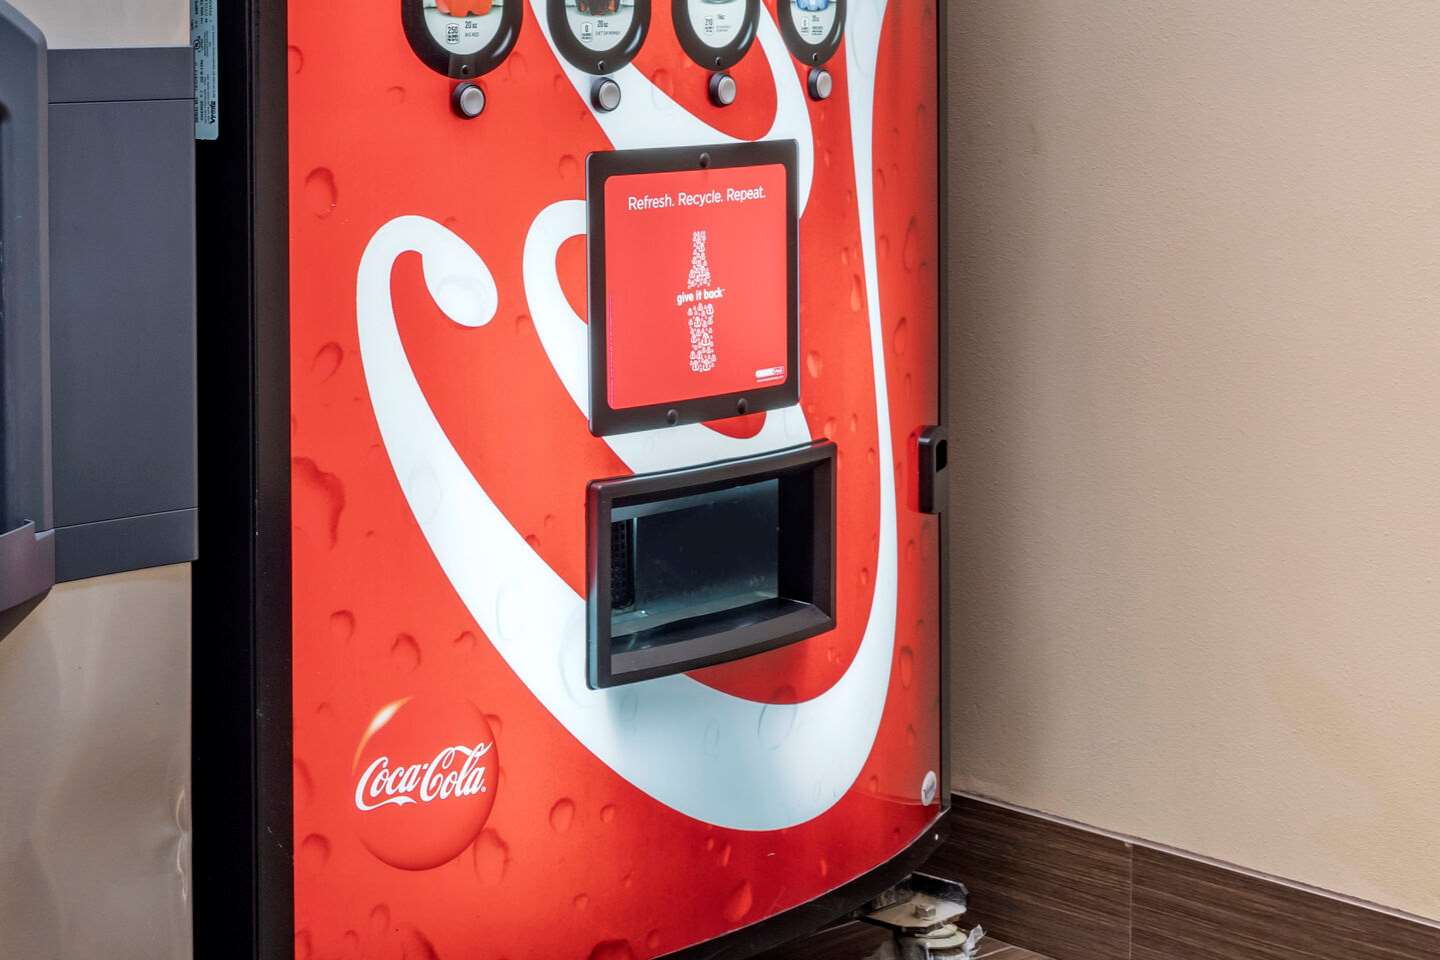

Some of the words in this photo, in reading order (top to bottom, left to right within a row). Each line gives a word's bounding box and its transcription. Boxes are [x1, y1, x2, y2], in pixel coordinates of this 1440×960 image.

[627, 193, 675, 211] Refresh.
[678, 190, 723, 207] Recycle.
[726, 185, 766, 203] Repeat.
[676, 291, 694, 306] give
[695, 289, 702, 301] it
[703, 287, 723, 300] back
[354, 740, 493, 811] Coca-Cola
